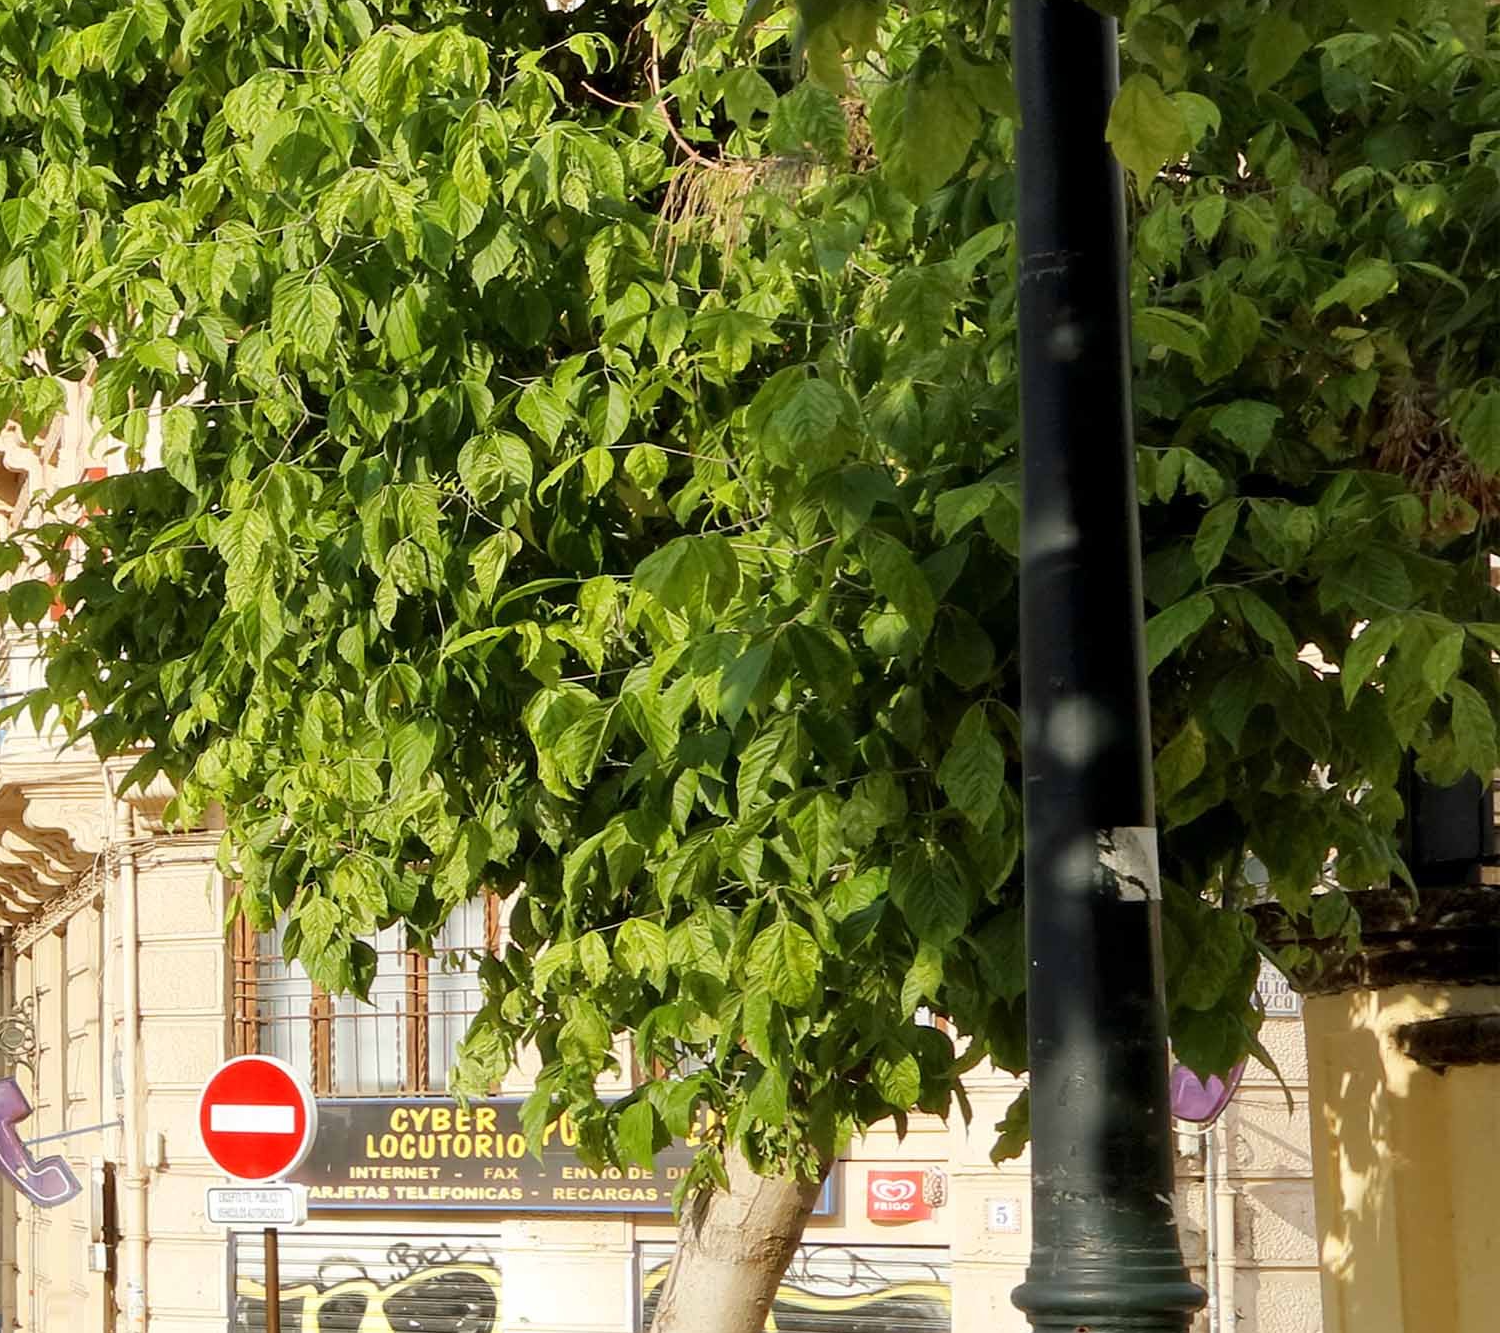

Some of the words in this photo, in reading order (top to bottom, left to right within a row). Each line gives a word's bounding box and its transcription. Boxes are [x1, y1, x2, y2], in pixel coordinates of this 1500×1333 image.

[390, 1107, 497, 1133] CYBER
[365, 1133, 526, 1160] LOCUTORIO
[350, 1167, 440, 1179] INTERNET
[484, 1167, 519, 1179] FAX
[628, 1167, 653, 1180] DE
[394, 1186, 524, 1200] TELEFONICAS
[553, 1187, 658, 1201] RECARGAS
[873, 1202, 911, 1211] FRIGO
[995, 1206, 1008, 1225] 5
